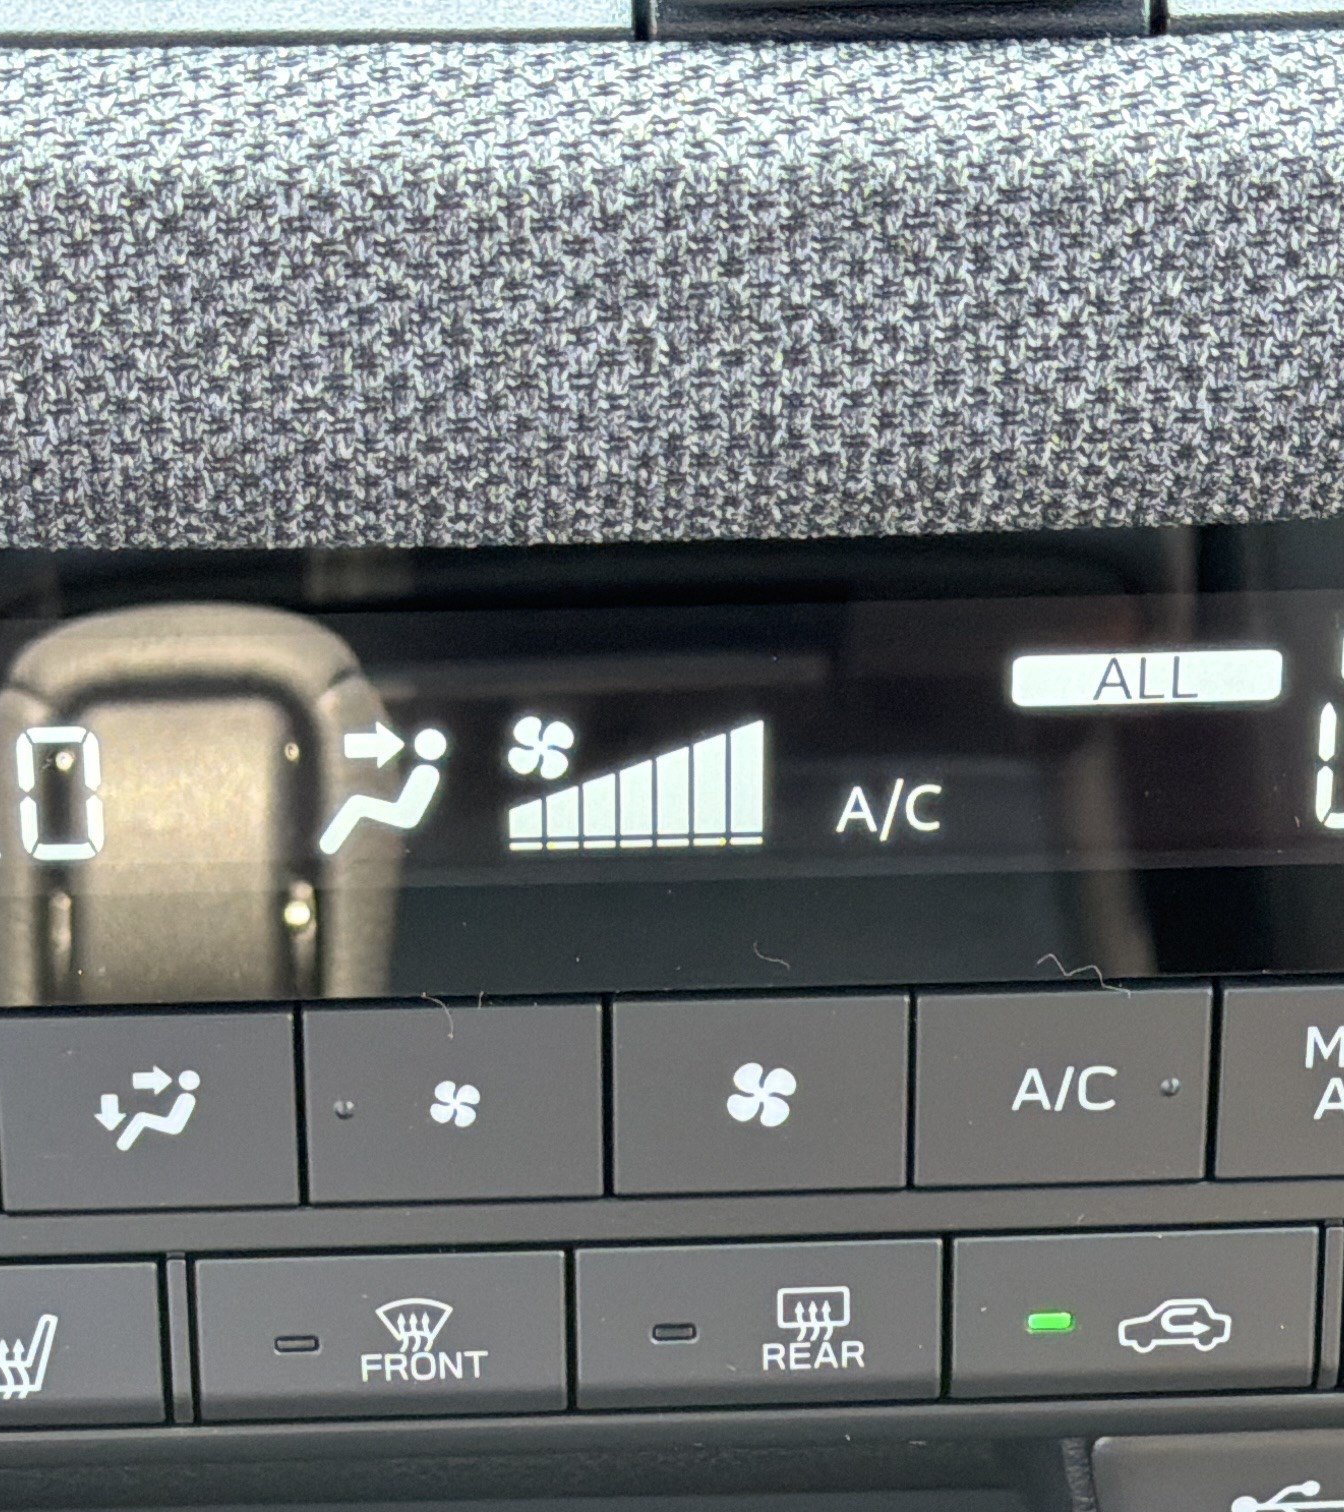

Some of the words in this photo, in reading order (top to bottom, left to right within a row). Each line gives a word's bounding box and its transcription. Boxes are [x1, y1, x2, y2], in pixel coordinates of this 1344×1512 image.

[1092, 655, 1200, 701] ALL
[836, 778, 942, 842] A/C
[1011, 1065, 1118, 1112] A/C
[360, 1350, 489, 1382] FRONT
[762, 1340, 865, 1371] REAR
